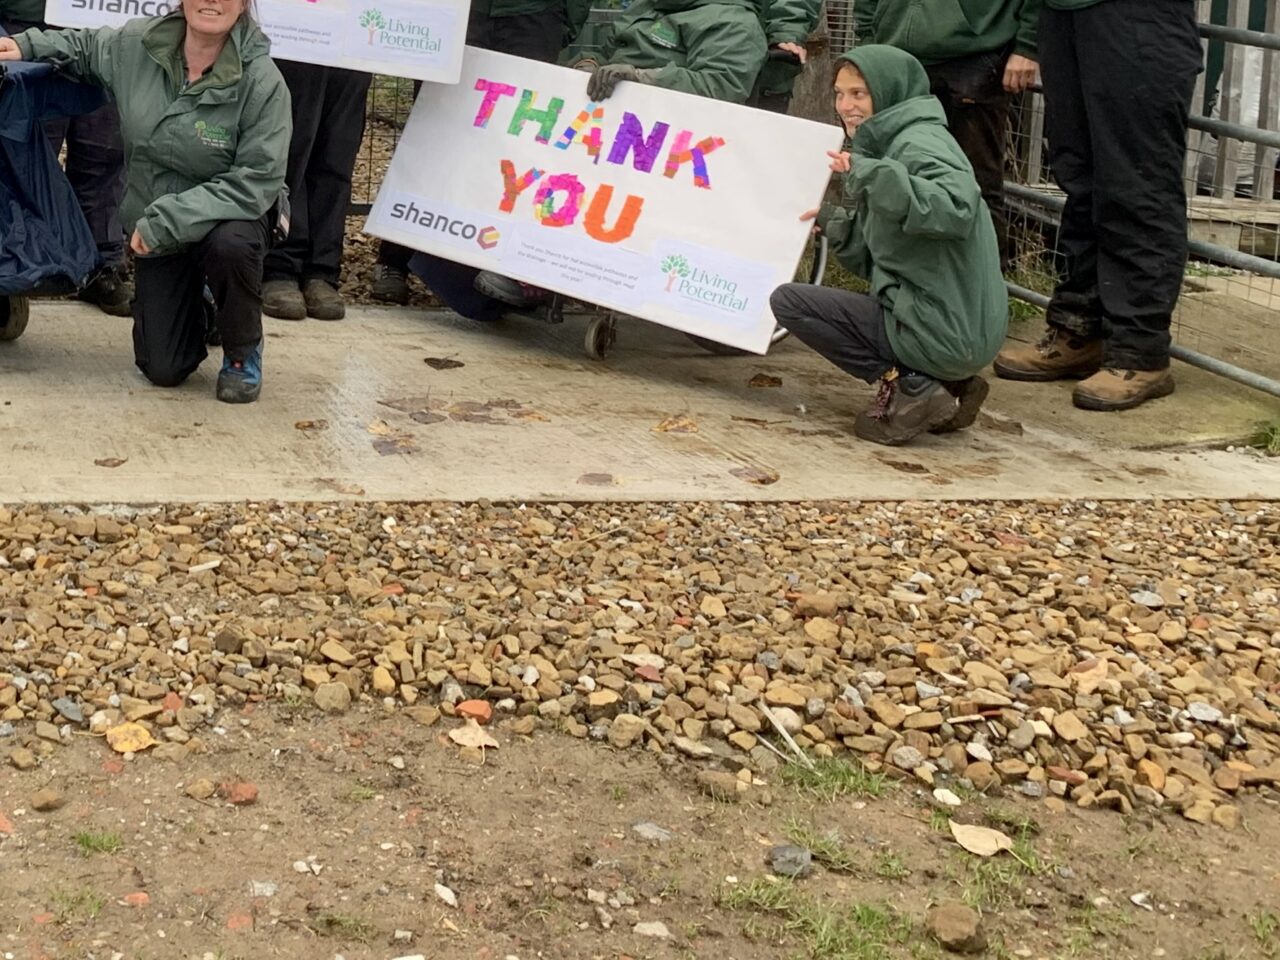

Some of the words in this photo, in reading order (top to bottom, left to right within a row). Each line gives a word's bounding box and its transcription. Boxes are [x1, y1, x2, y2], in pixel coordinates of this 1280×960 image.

[379, 31, 442, 53] Potential
[388, 18, 430, 39] Living
[473, 78, 726, 190] THANK
[498, 159, 645, 244] YOU
[390, 201, 477, 240] shanco
[678, 279, 749, 312] Potential
[691, 267, 738, 295] Living
